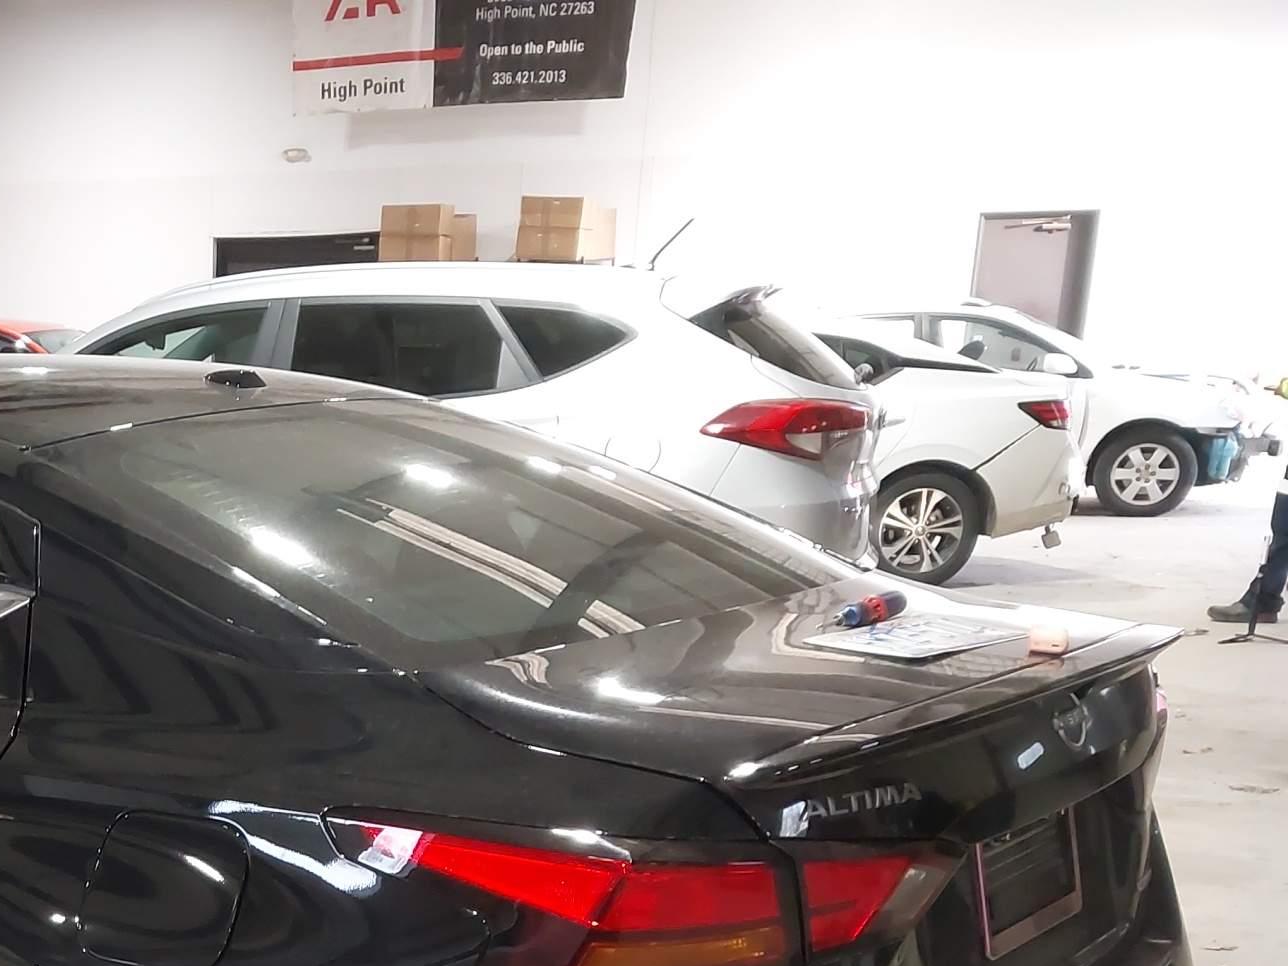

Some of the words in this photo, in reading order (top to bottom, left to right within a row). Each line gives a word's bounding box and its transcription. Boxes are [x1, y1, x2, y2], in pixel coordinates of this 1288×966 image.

[475, 6, 501, 22] High
[504, 5, 536, 19] Point,
[539, 3, 557, 16] NC
[560, 1, 595, 15] 27263
[479, 43, 509, 60] Open
[511, 43, 523, 55] to
[524, 41, 544, 55] the
[547, 39, 585, 53] Public
[492, 69, 567, 85] 336.421.2013
[321, 80, 358, 102] High
[364, 76, 406, 97] Point
[799, 782, 923, 822] ALTIMA
